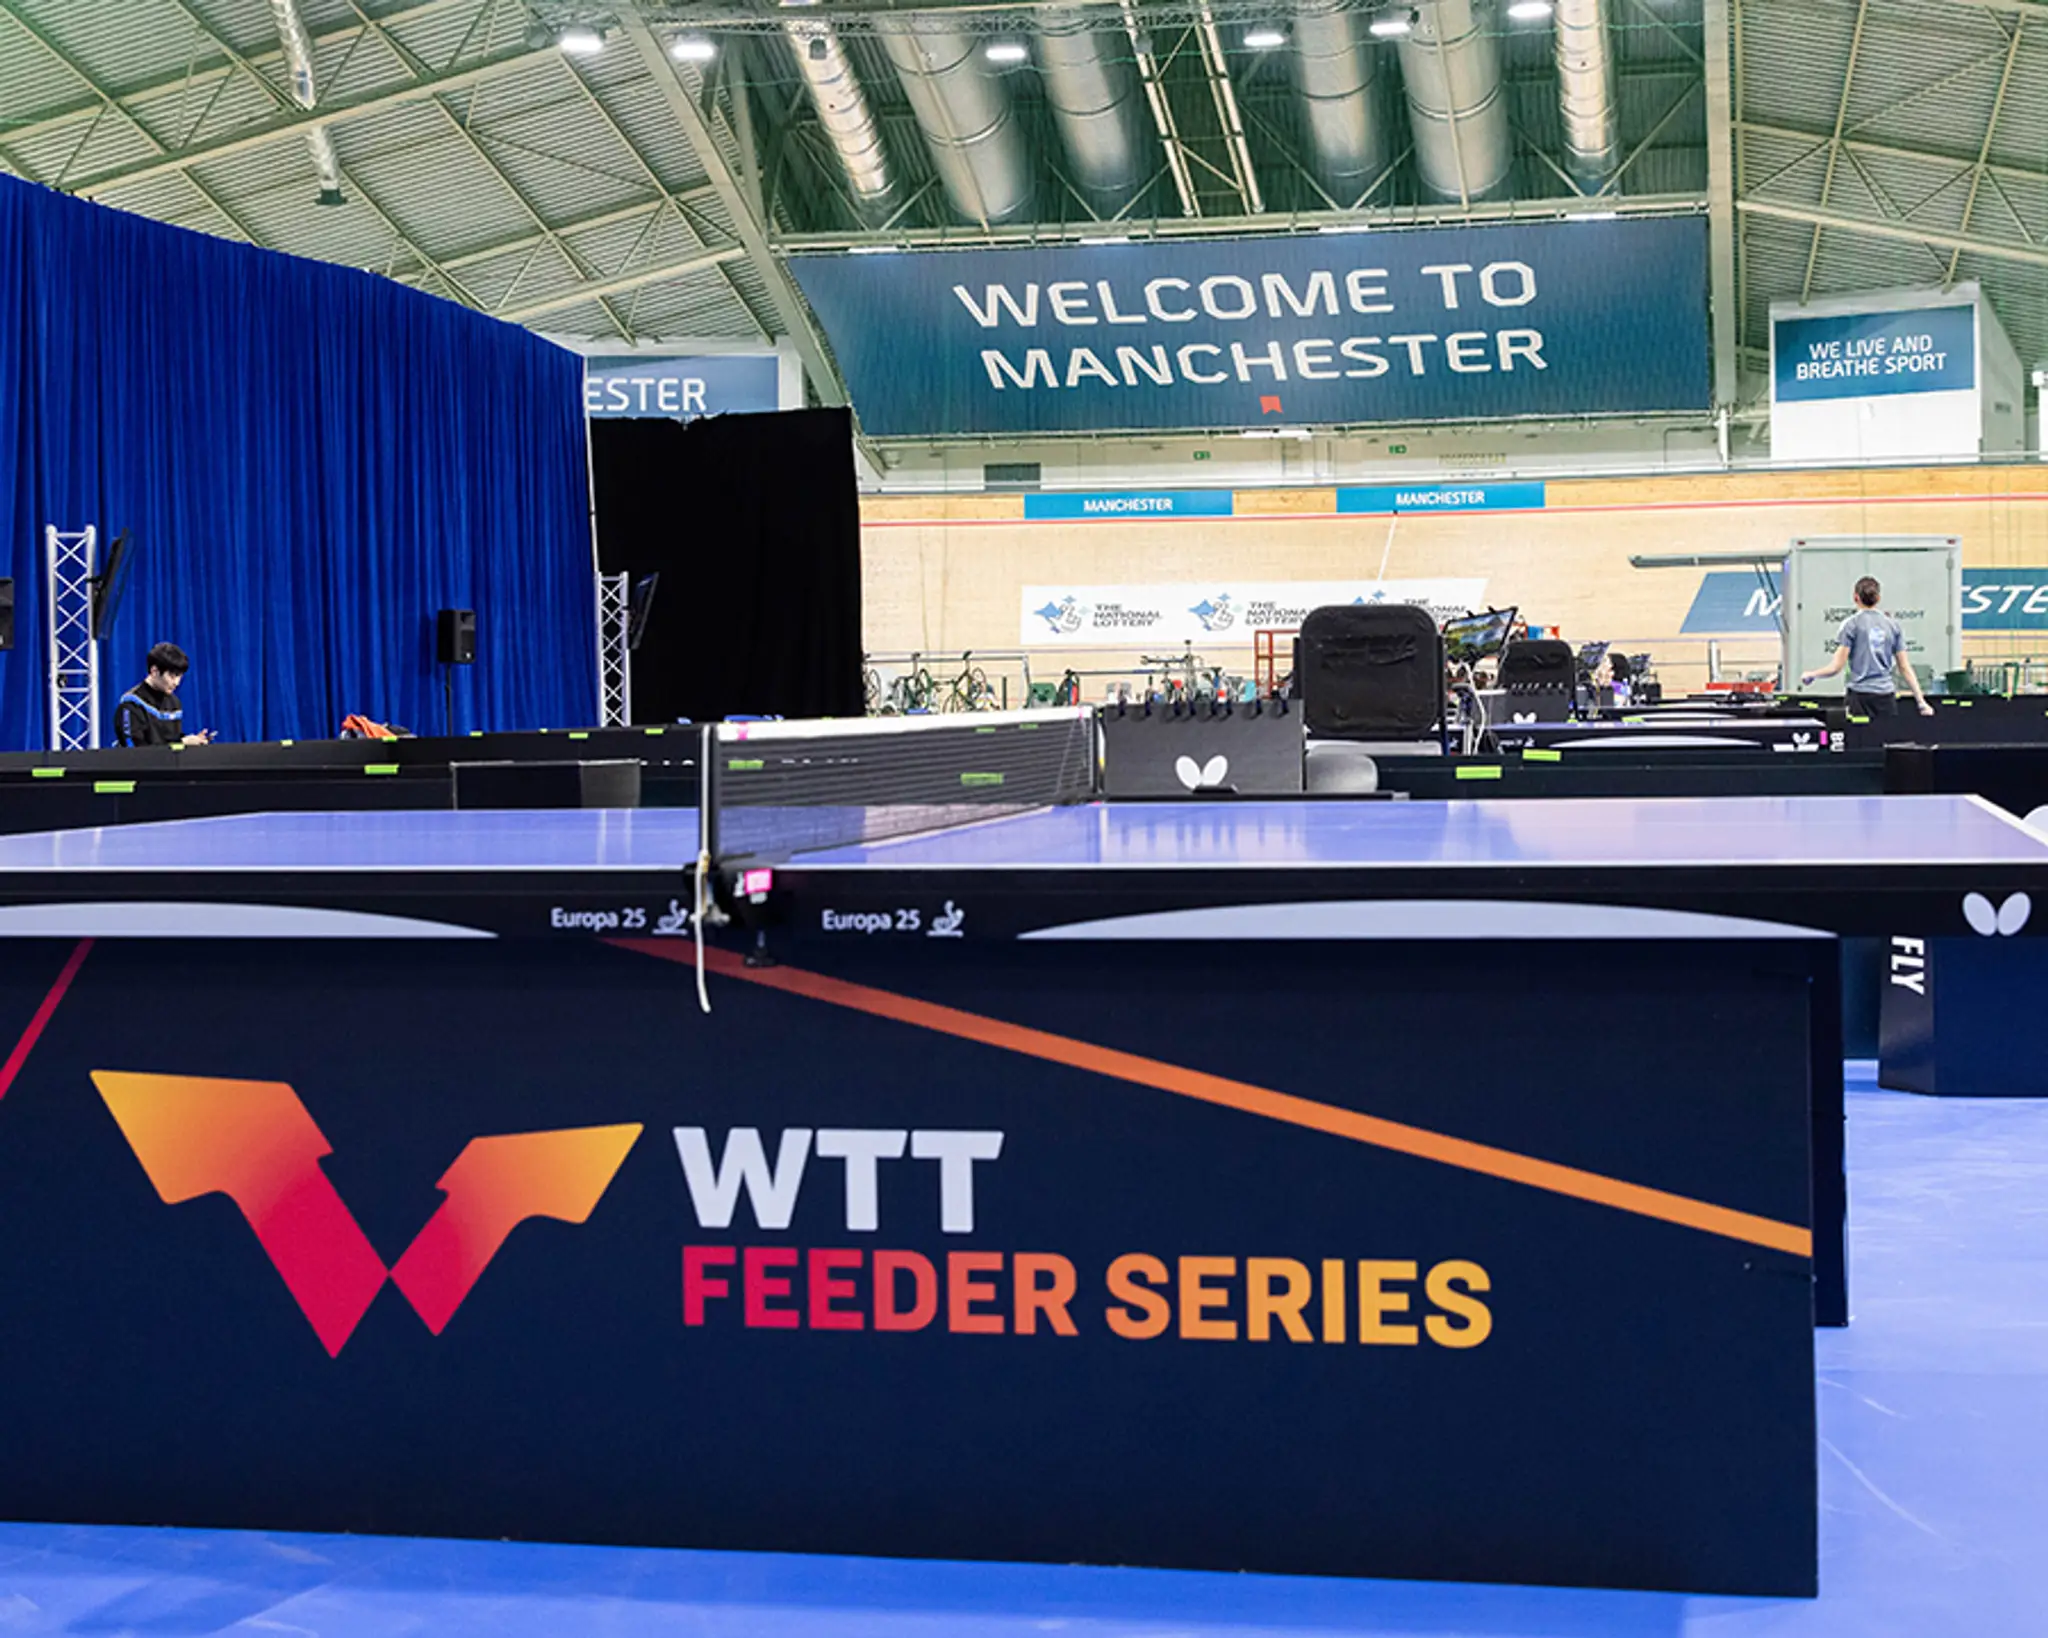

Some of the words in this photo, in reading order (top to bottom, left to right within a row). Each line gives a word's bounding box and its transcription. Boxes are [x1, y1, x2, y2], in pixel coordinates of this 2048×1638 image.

[953, 269, 1394, 327] WELCOME
[1421, 261, 1537, 309] TO
[981, 329, 1548, 388] MANCHESTER
[1809, 341, 1841, 360] WE
[1846, 337, 1886, 357] LIVE
[1892, 334, 1933, 354] AND
[1796, 357, 1880, 380] BREATHE
[1884, 352, 1947, 374] SPORT
[1084, 498, 1173, 512] MANCHESTER
[1395, 490, 1485, 506] MANCHESTER
[1094, 610, 1162, 619] NATIONAL
[1095, 603, 1122, 611] THE
[1093, 618, 1155, 628] LOTTERY
[551, 907, 618, 931] Europa
[622, 908, 647, 928] 25
[822, 909, 891, 932] Europa
[896, 909, 921, 930] 25
[1891, 935, 1925, 995] FLY
[673, 1127, 1004, 1233] WTT
[683, 1245, 1079, 1337] FEEDER
[1105, 1253, 1492, 1349] SERIES
